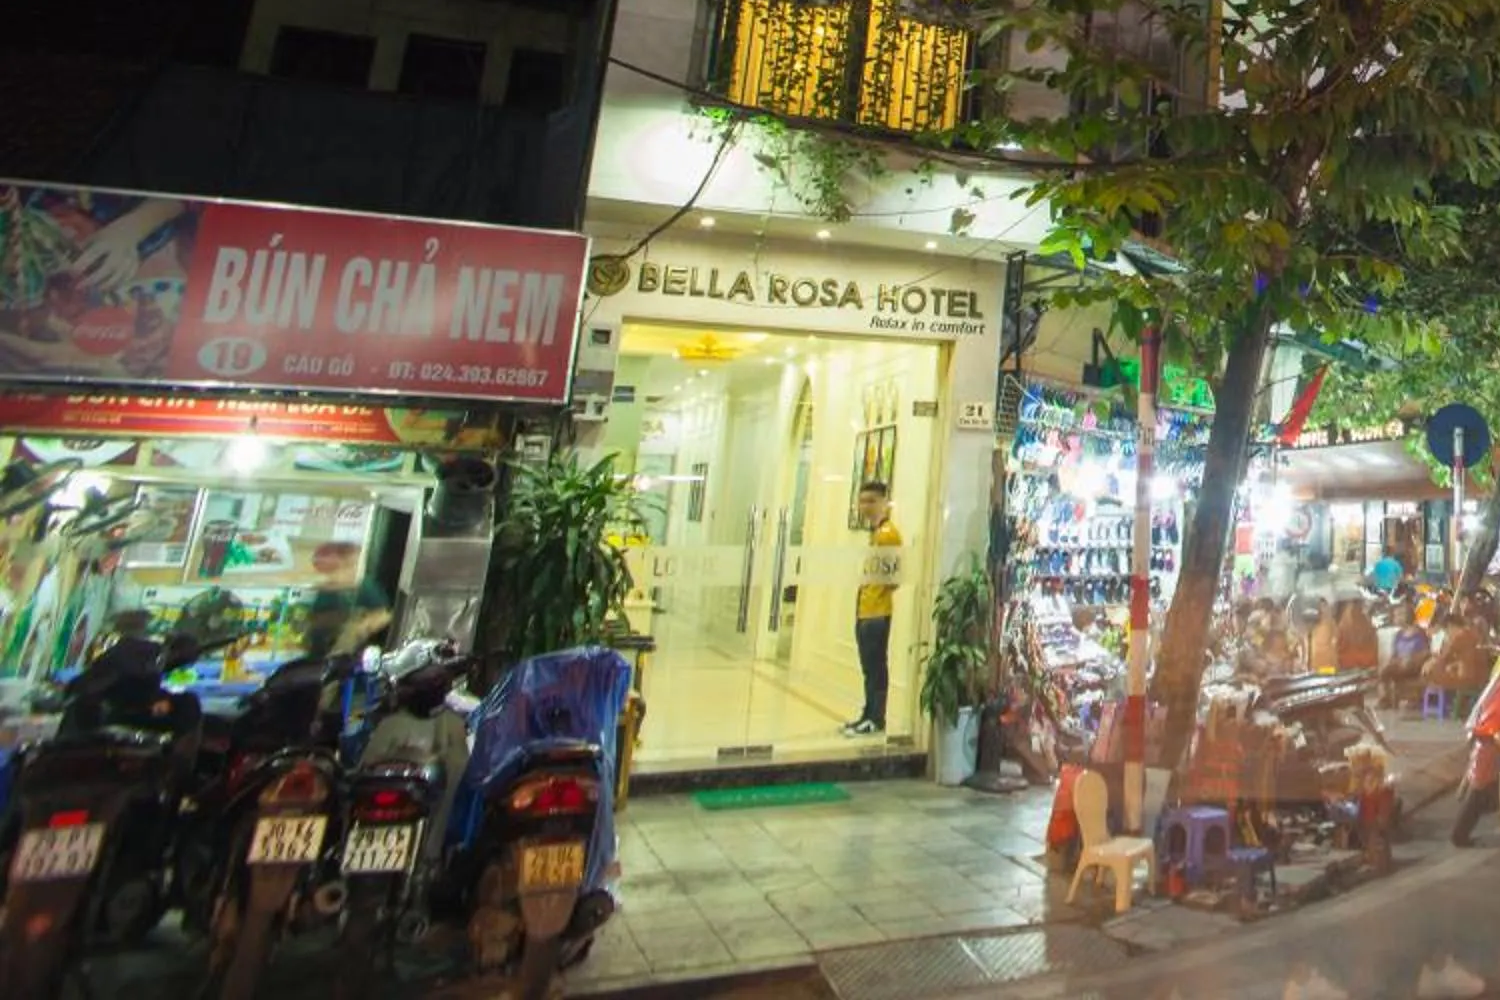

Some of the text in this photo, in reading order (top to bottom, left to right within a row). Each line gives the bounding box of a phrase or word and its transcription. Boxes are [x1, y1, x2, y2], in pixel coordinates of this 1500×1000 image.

[203, 232, 565, 345] BÚN CHẢ NEM
[637, 261, 985, 320] BELLA ROSA HOTEL
[869, 315, 986, 336] Relax in comfort
[965, 404, 983, 417] 21
